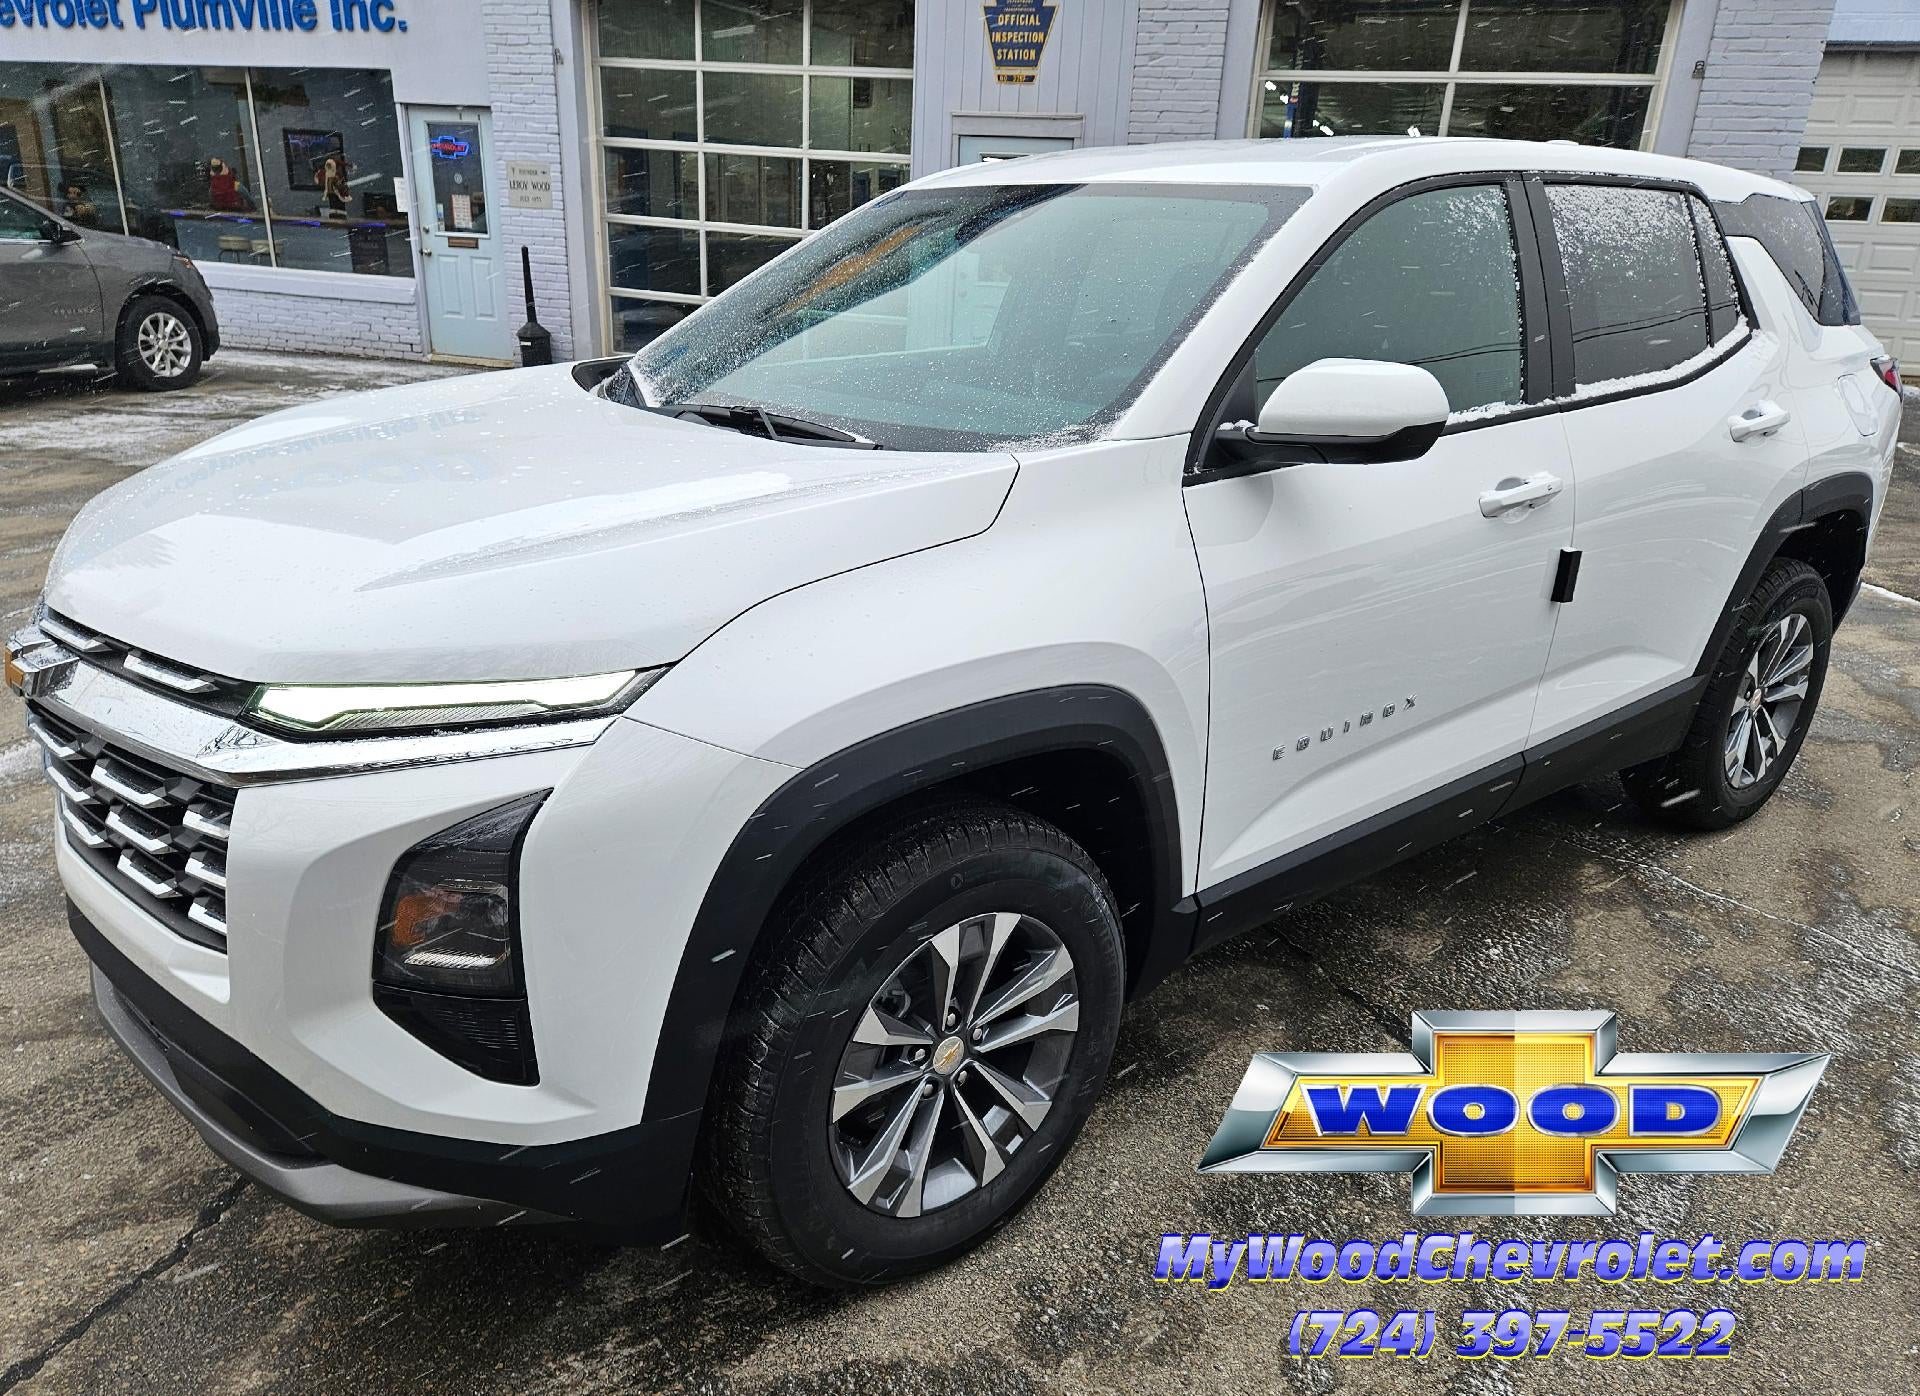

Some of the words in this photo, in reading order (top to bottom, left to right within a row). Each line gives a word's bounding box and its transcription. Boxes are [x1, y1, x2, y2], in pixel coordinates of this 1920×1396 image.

[134, 0, 318, 32] Plumville
[329, 0, 408, 33] Inc.
[997, 14, 1041, 26] OFFICIAL
[991, 31, 1045, 43] INSPECTION
[997, 49, 1036, 60] STATION
[531, 182, 551, 191] WOOD
[1272, 693, 1418, 761] EQUINOX
